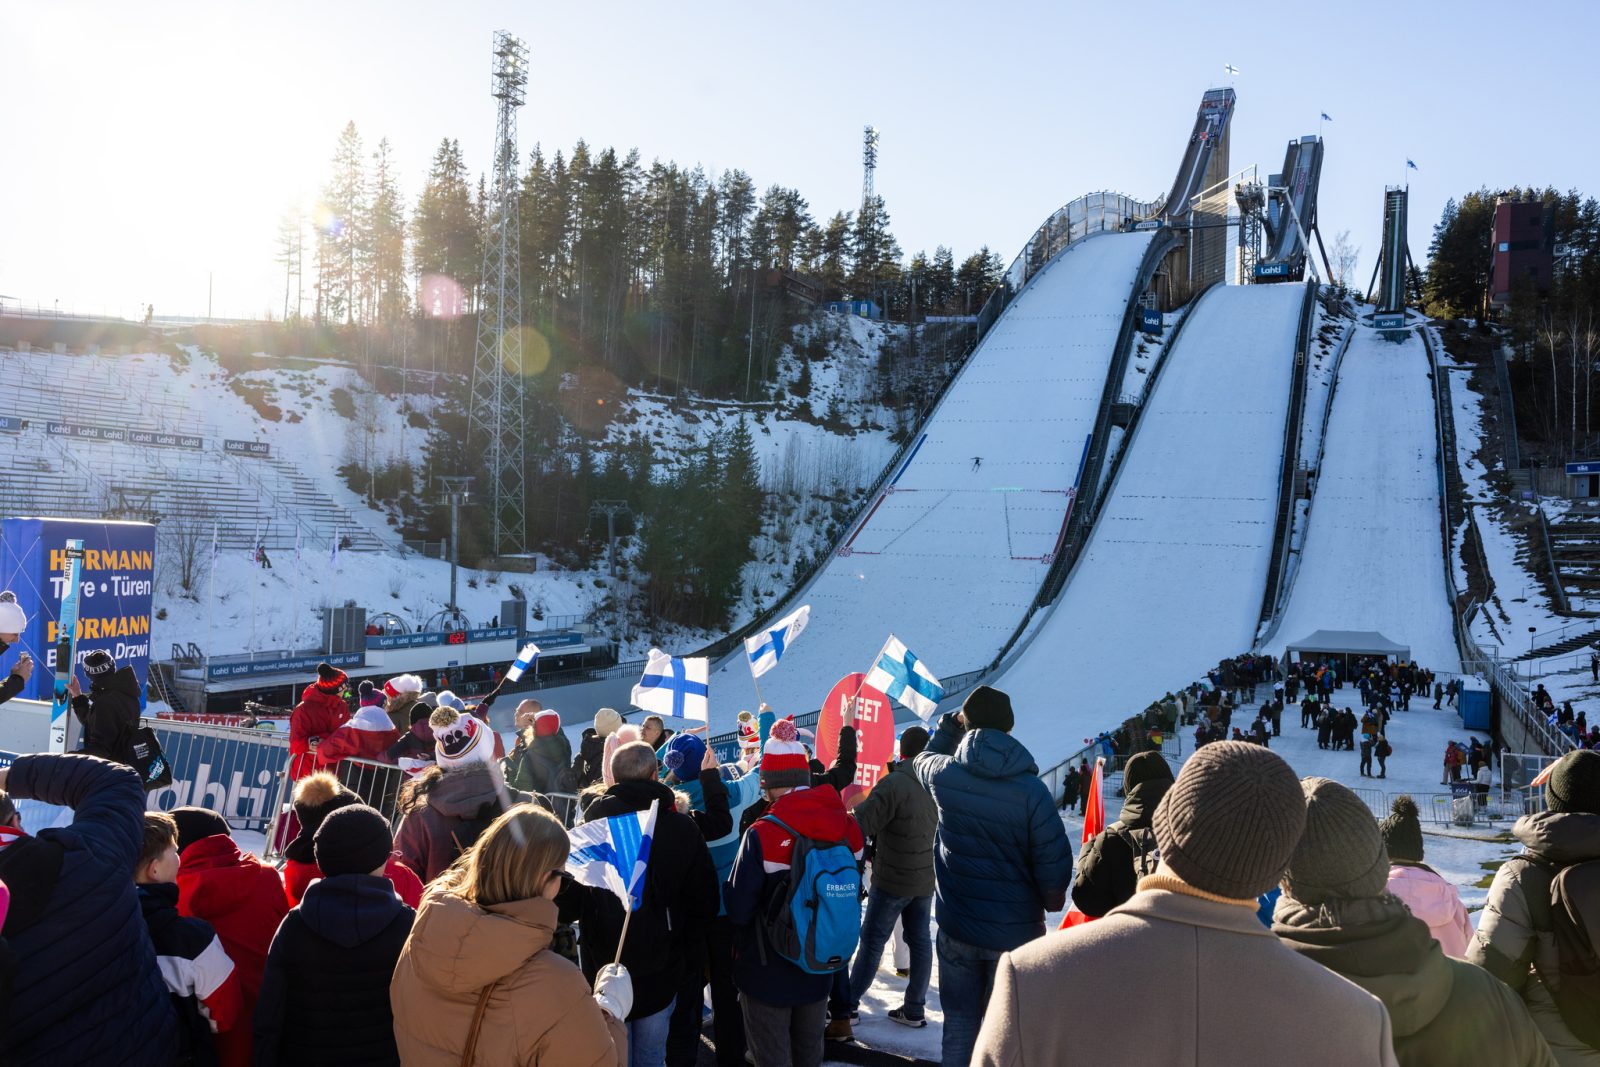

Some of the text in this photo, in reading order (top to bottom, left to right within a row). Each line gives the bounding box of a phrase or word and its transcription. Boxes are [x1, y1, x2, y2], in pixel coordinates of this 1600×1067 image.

[1260, 265, 1282, 274] Lahti
[1144, 316, 1160, 326] Lahti
[50, 425, 123, 440] Lahti Lahti Lahti
[132, 433, 199, 447] Lahti Lahti Lahti
[227, 442, 267, 452] Lahti Lahti
[50, 549, 152, 571] HRMANN
[50, 576, 151, 599] Tre Türen
[380, 638, 394, 646] Lahti
[115, 640, 149, 660] Drzwi
[213, 667, 229, 676] Lahti
[232, 664, 249, 674] Lahti
[330, 656, 344, 664] Lahti
[346, 655, 360, 663] Lahti
[854, 762, 880, 787] EET
[147, 763, 271, 829] ahti
[826, 883, 856, 892] ERBACER
